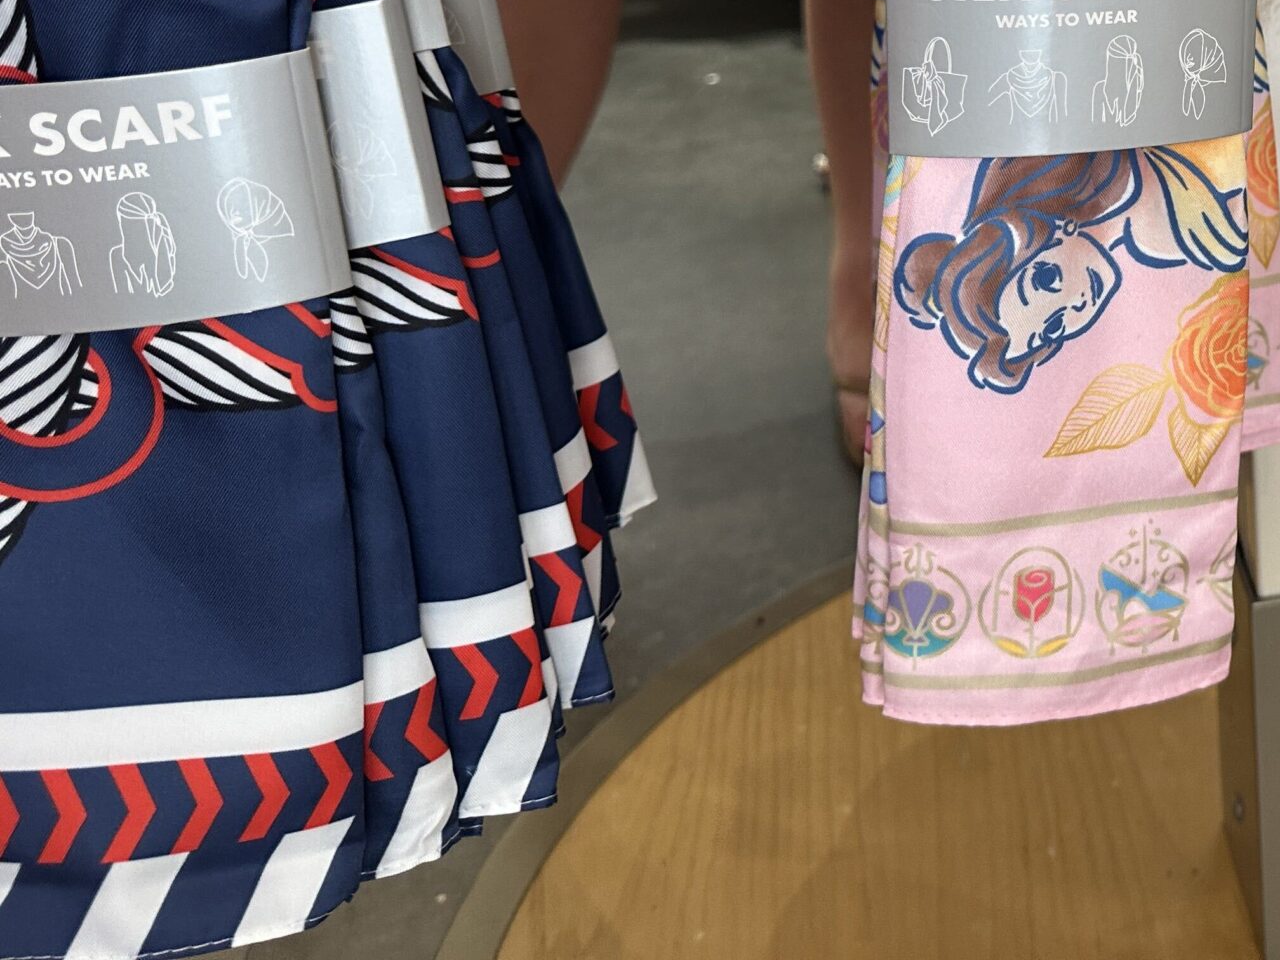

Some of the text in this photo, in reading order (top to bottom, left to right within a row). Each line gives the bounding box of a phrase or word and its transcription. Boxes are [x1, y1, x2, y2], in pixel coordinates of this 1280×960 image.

[995, 9, 1138, 29] WAYS TO WEAR
[29, 94, 233, 157] SCARF
[41, 169, 73, 186] TO
[79, 162, 151, 183] WEAR
